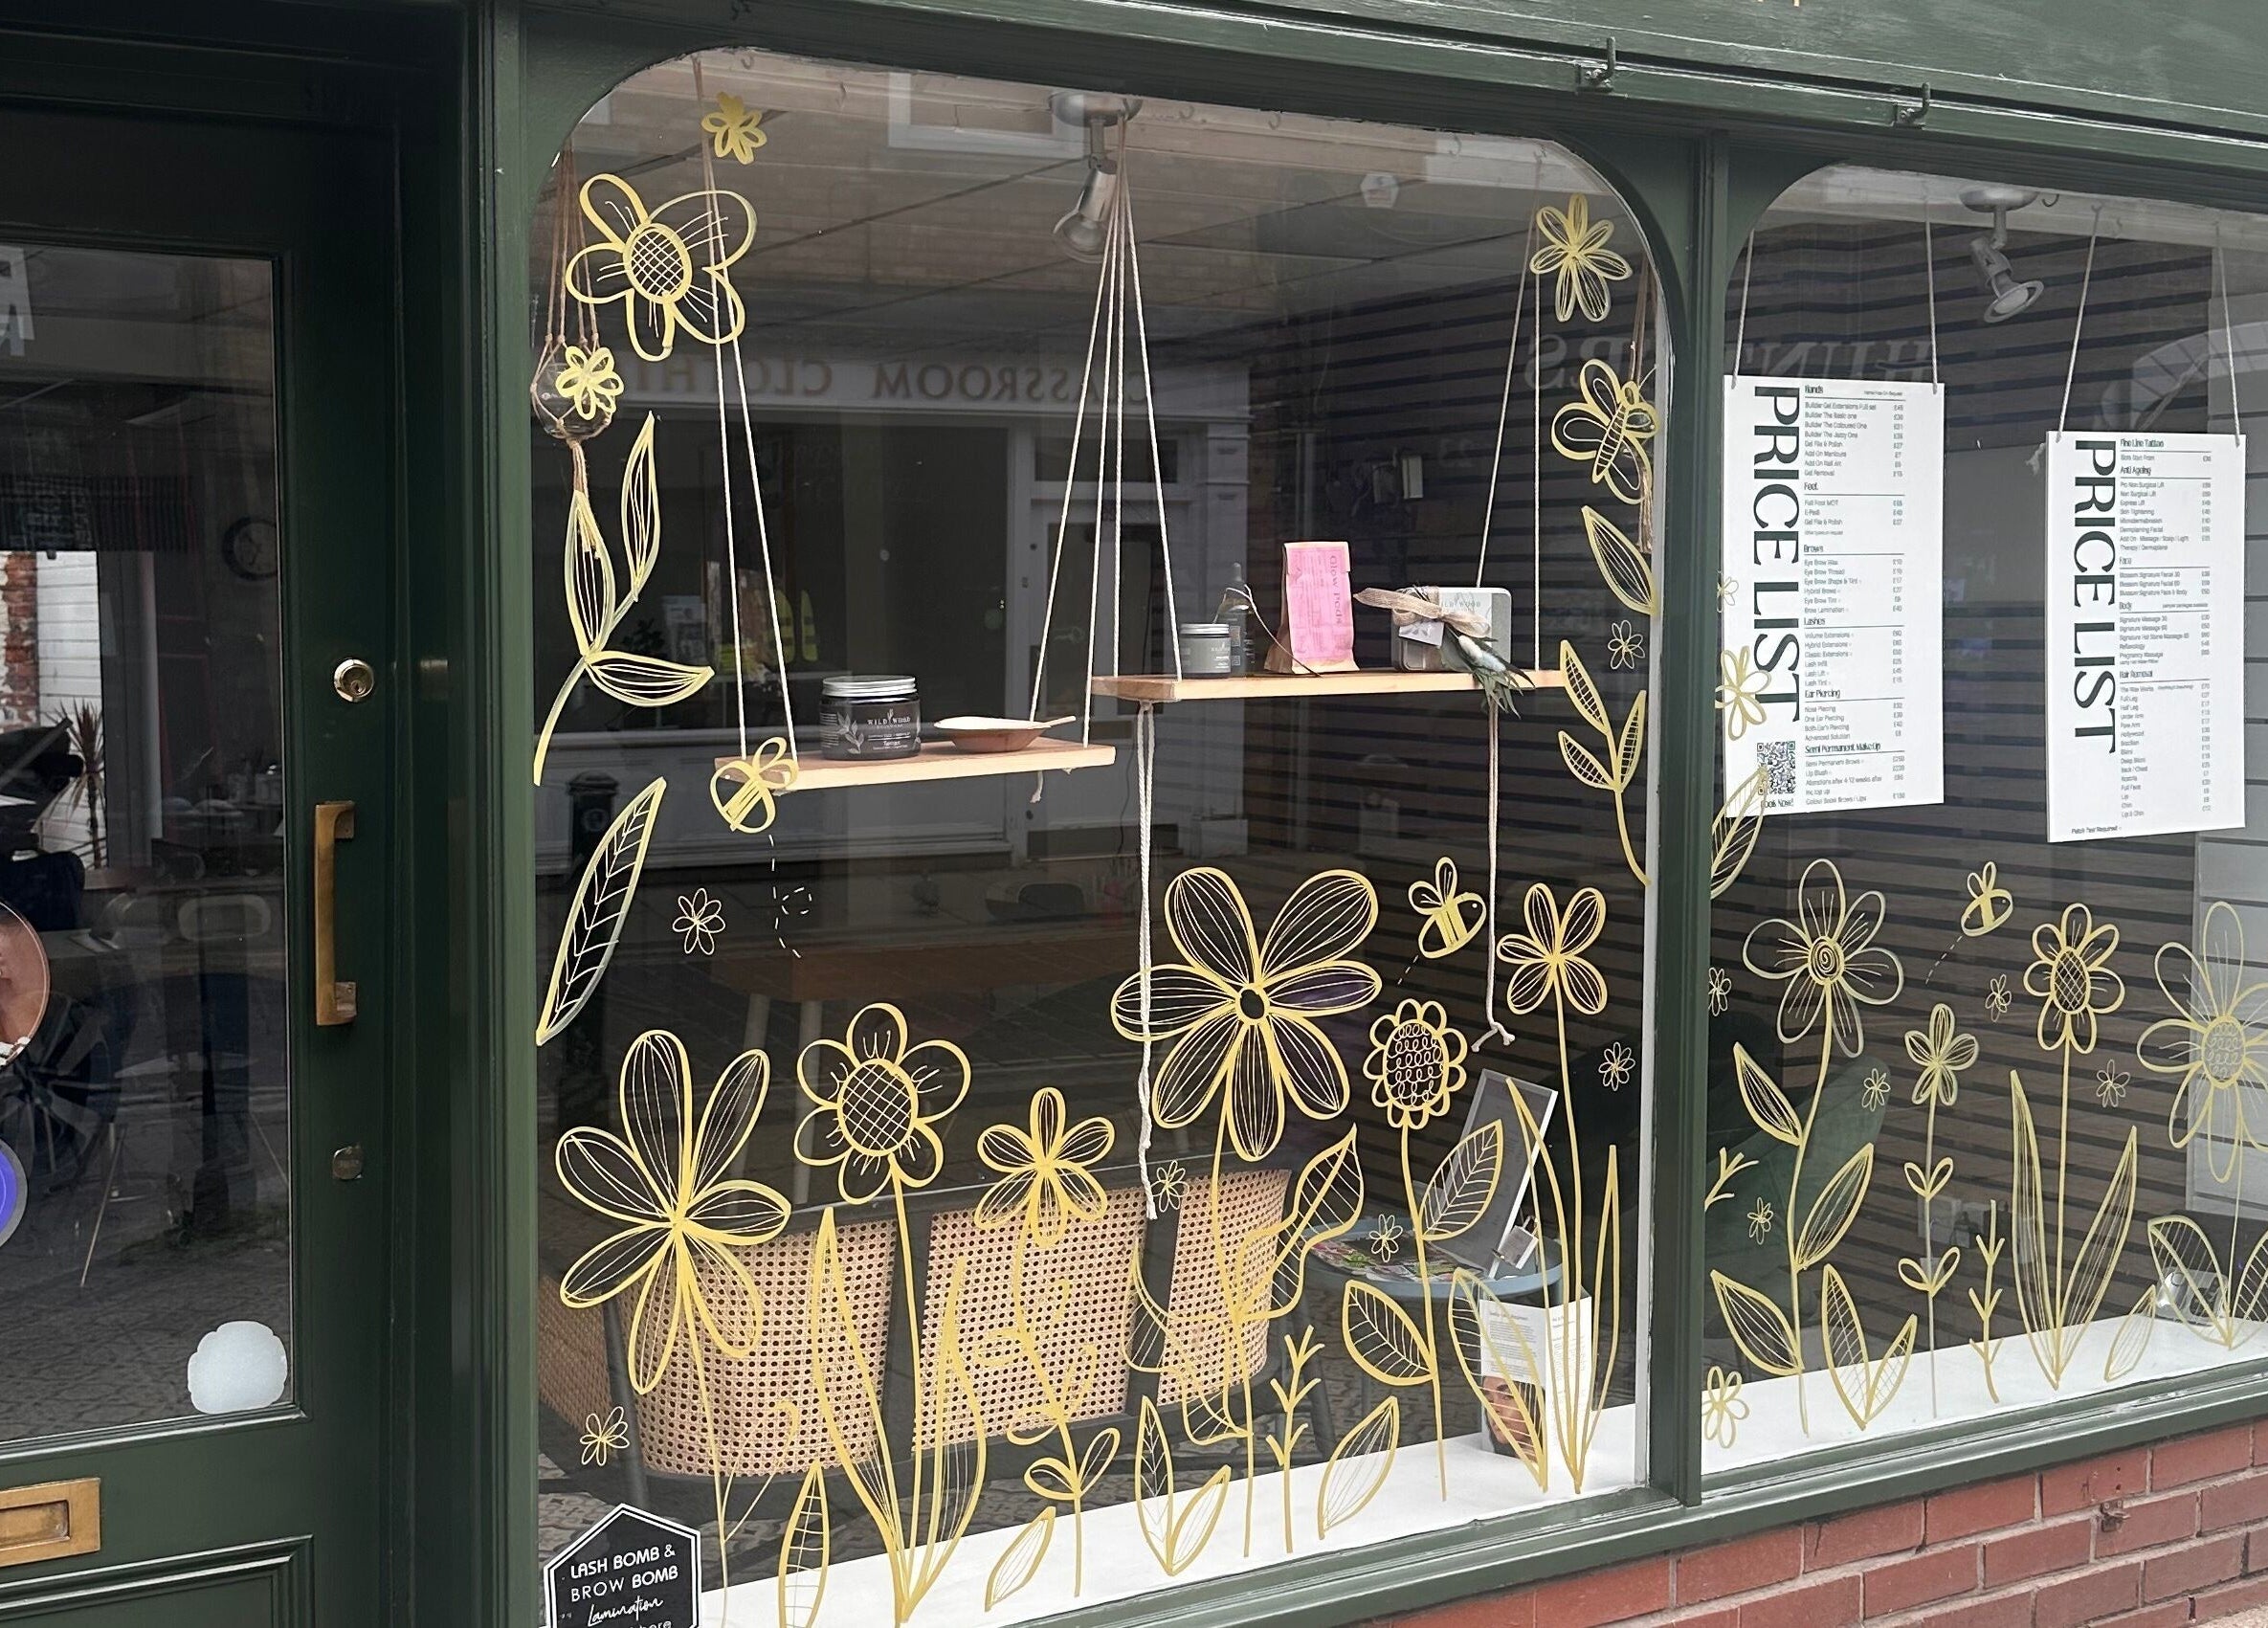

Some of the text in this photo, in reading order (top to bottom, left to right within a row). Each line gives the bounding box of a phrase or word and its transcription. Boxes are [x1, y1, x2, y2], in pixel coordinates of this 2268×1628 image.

[1754, 387, 1800, 723] PRICE LIST
[2075, 440, 2116, 754] PRICE LIST
[1804, 617, 1825, 626] Lashes
[570, 1544, 676, 1579] LASH BOMB &
[570, 1565, 678, 1602] BROW BOMB
[588, 1595, 664, 1627] Lamination
